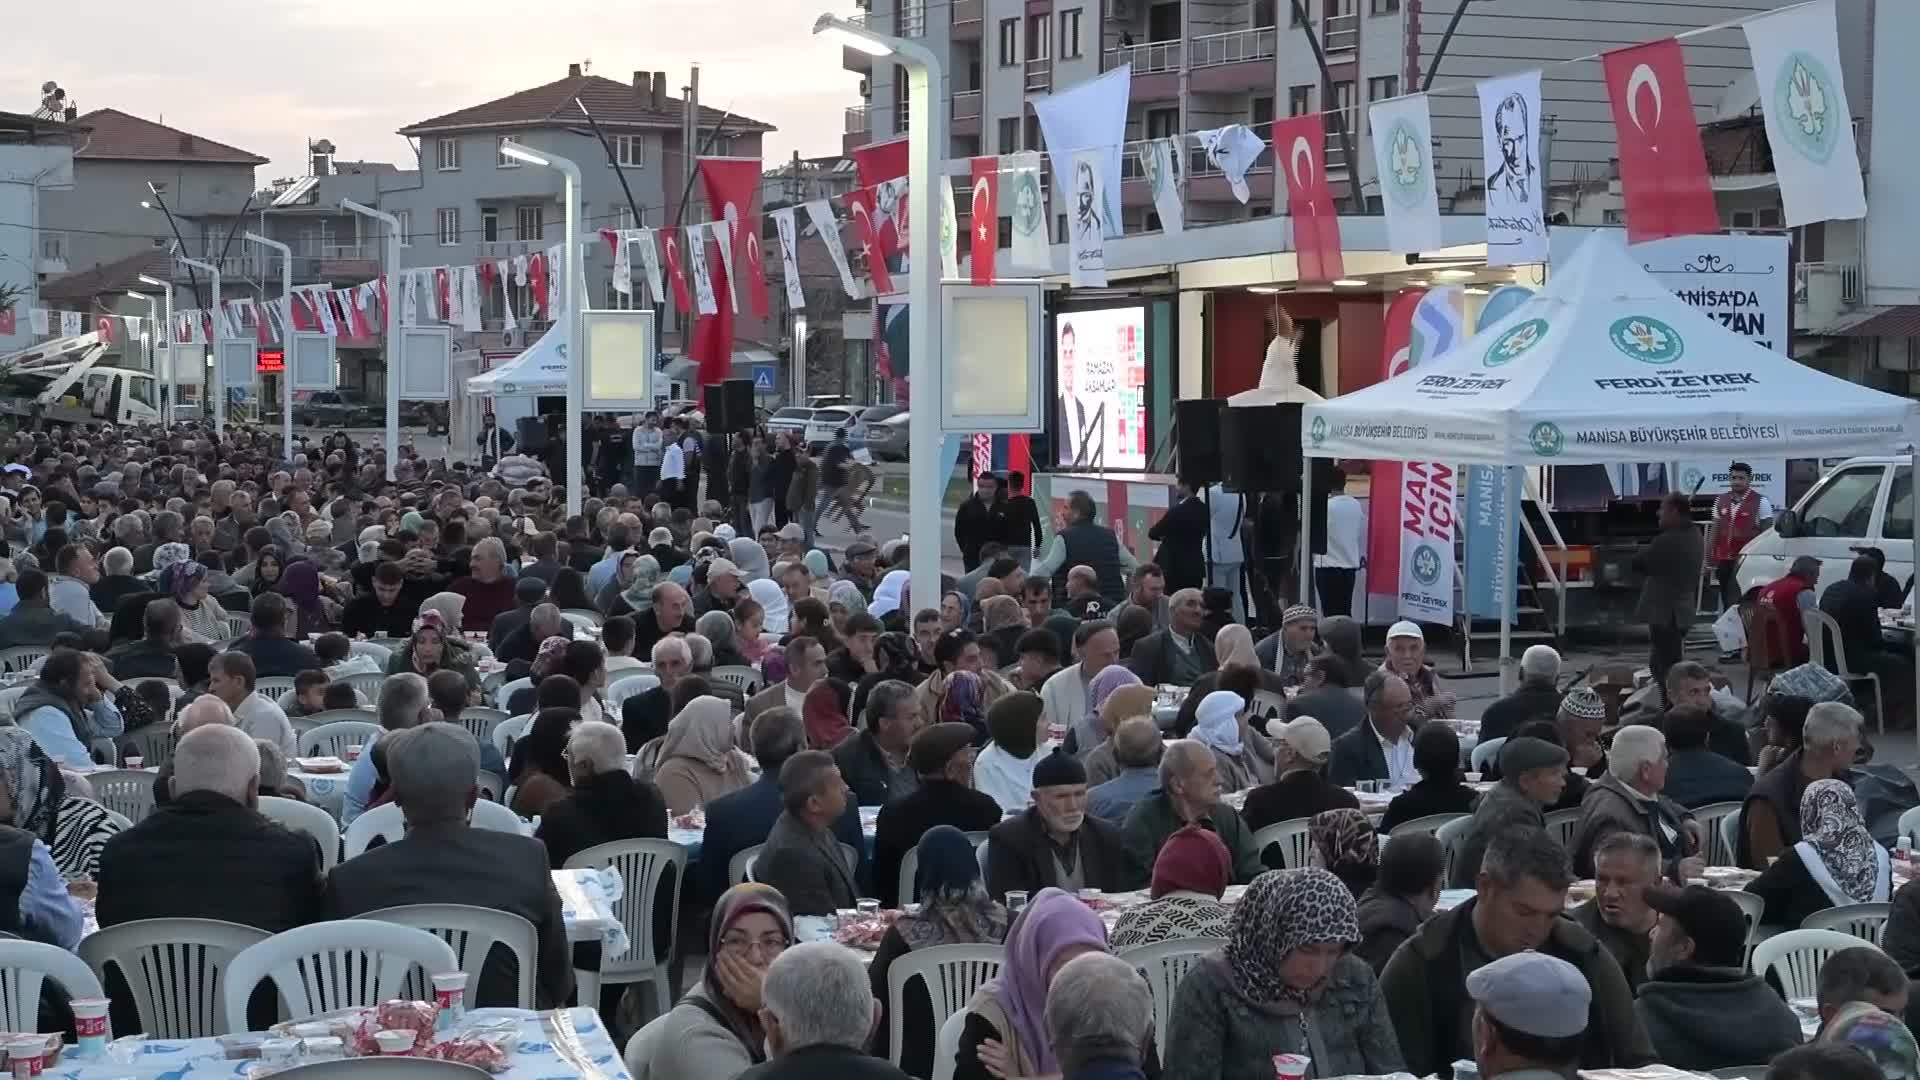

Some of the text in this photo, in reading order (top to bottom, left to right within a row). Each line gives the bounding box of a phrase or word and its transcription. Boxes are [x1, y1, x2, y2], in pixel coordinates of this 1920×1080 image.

[1671, 286, 1759, 306] ANİSA'DA
[1666, 373, 1760, 388] ZEYREK
[1353, 423, 1392, 440] BÜYÜKŞEHİR
[1392, 424, 1428, 440] BELEDİYESİ
[1576, 423, 1779, 444] MANİSA BÜYÜKŞEHİR BELEDİYESİ
